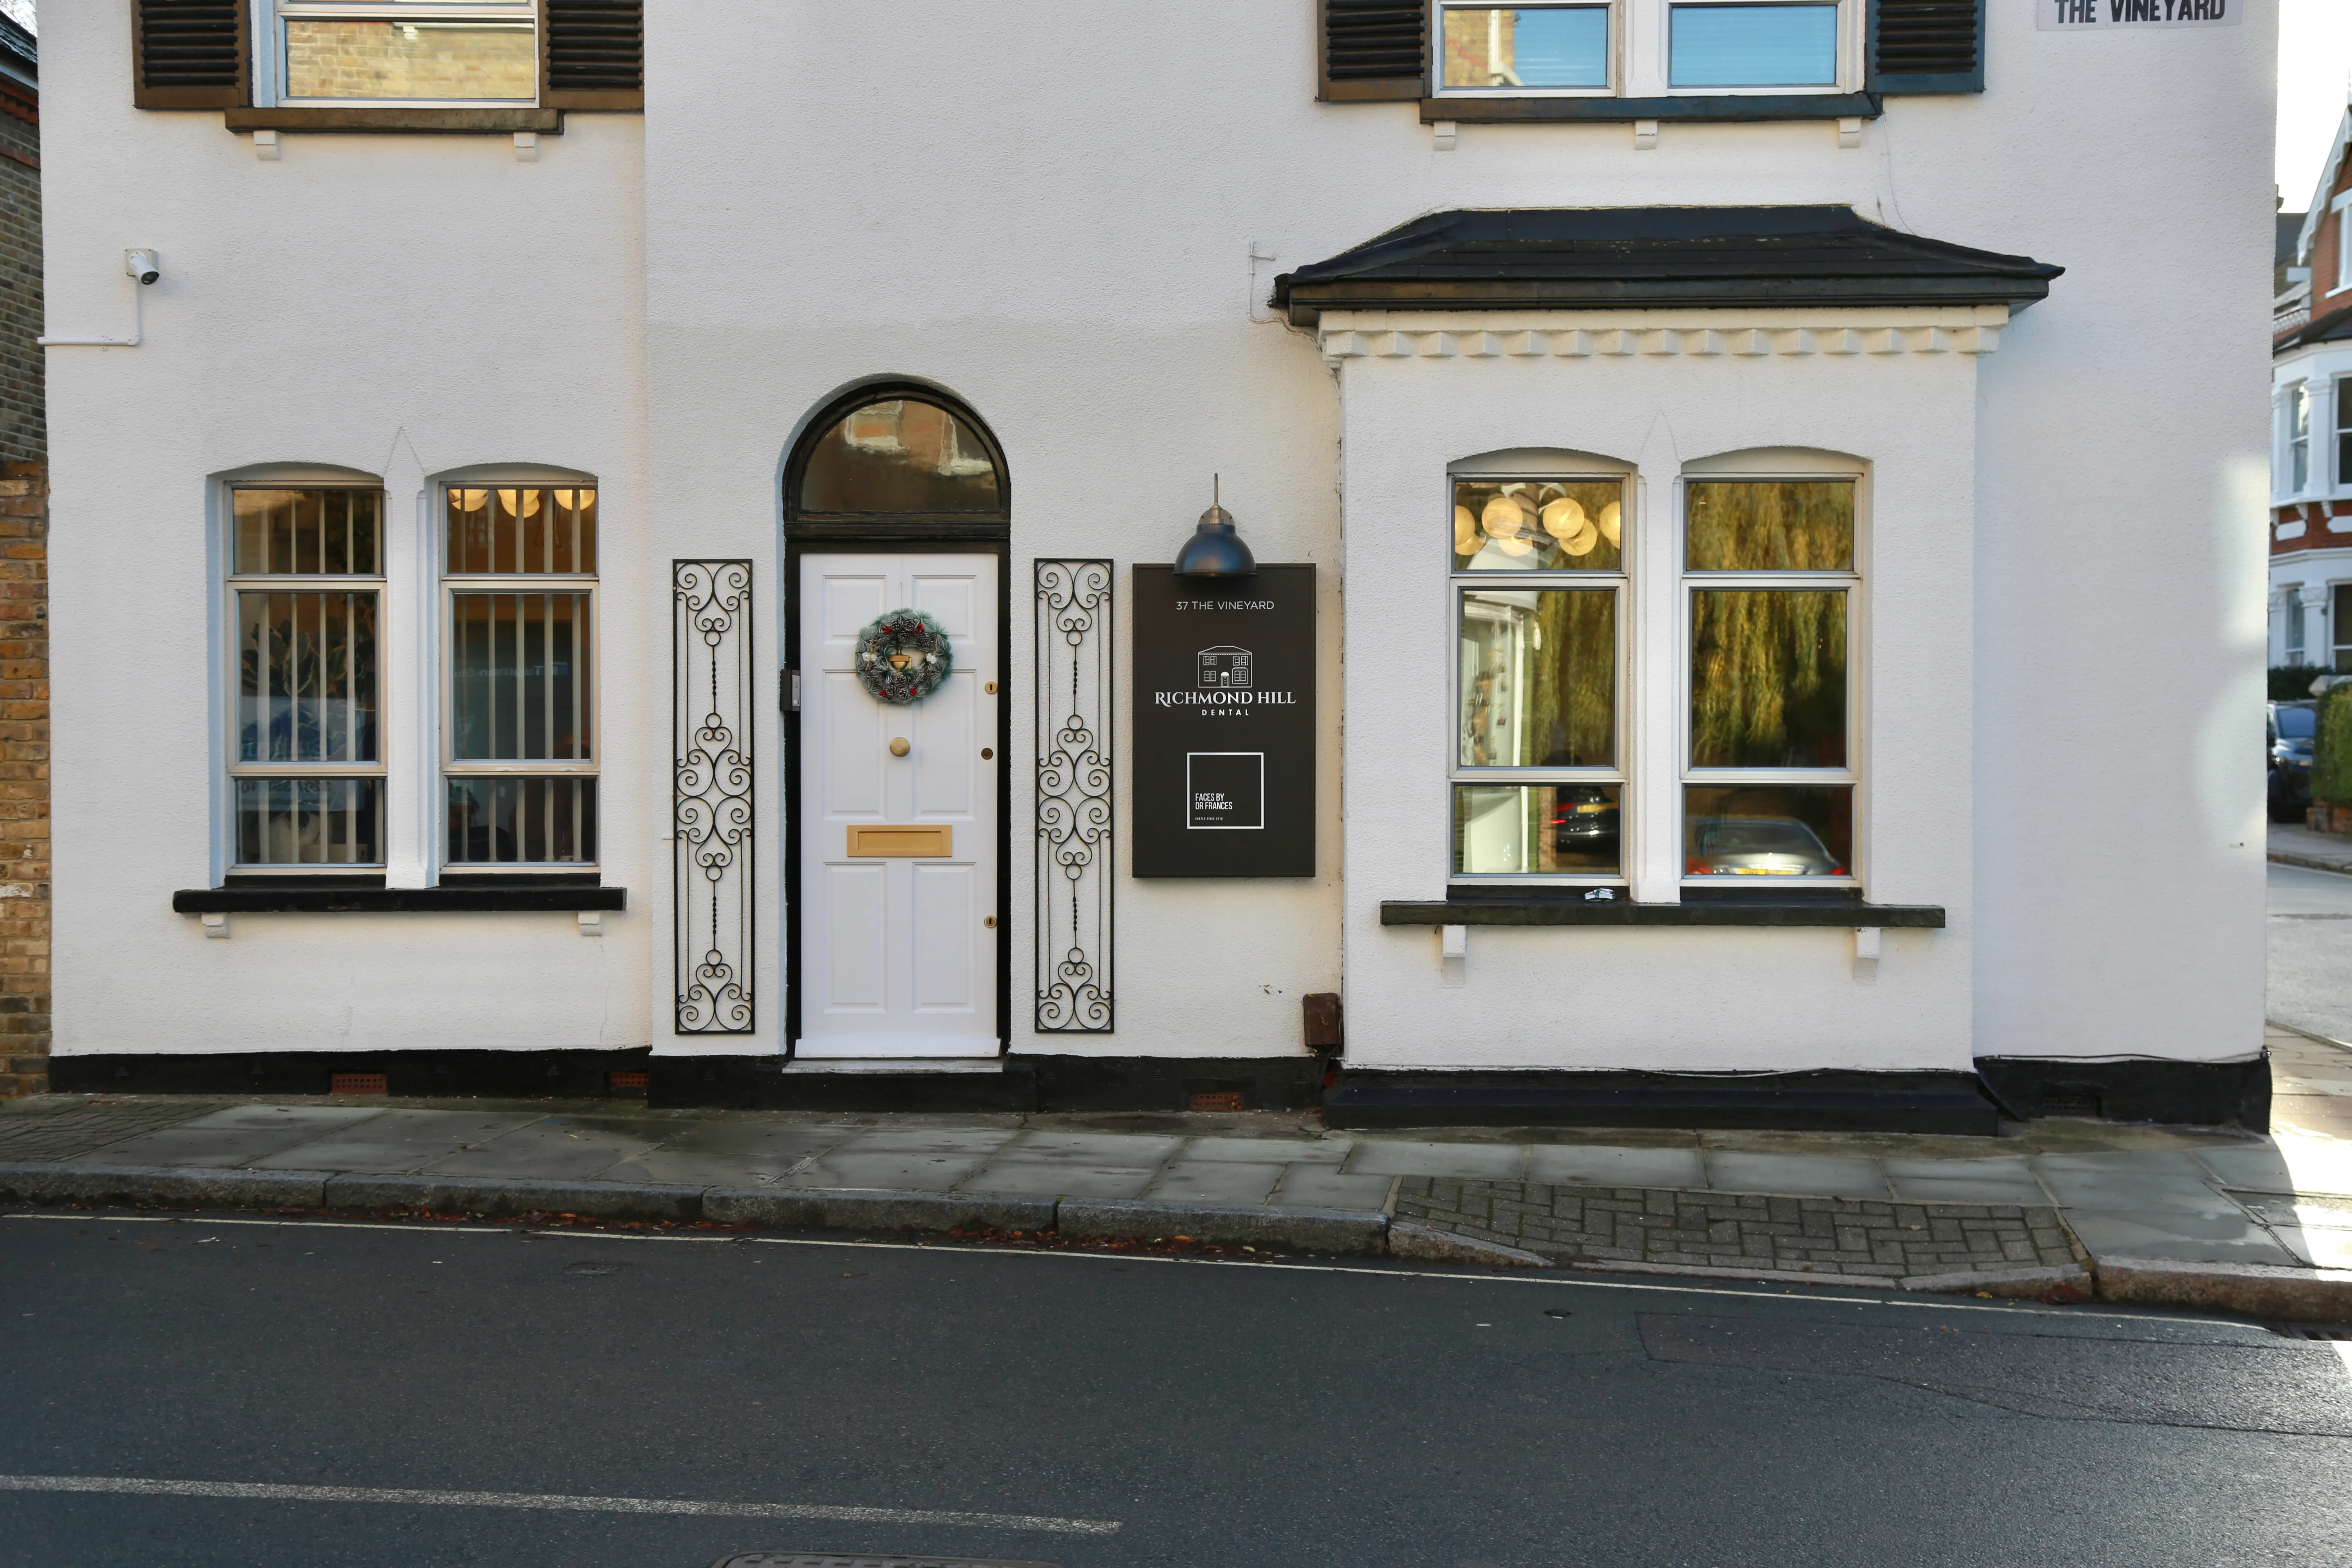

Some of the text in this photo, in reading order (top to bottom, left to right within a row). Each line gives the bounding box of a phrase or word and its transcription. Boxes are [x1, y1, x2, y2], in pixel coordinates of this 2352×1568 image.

[2054, 0, 2225, 23] THE VINEYARD
[1176, 601, 1274, 610] 37 THE VINEYARD
[1155, 692, 1296, 707] RICHMOND HILL
[1195, 793, 1225, 801] FACES BY
[1195, 802, 1233, 810] DR FRANCES
